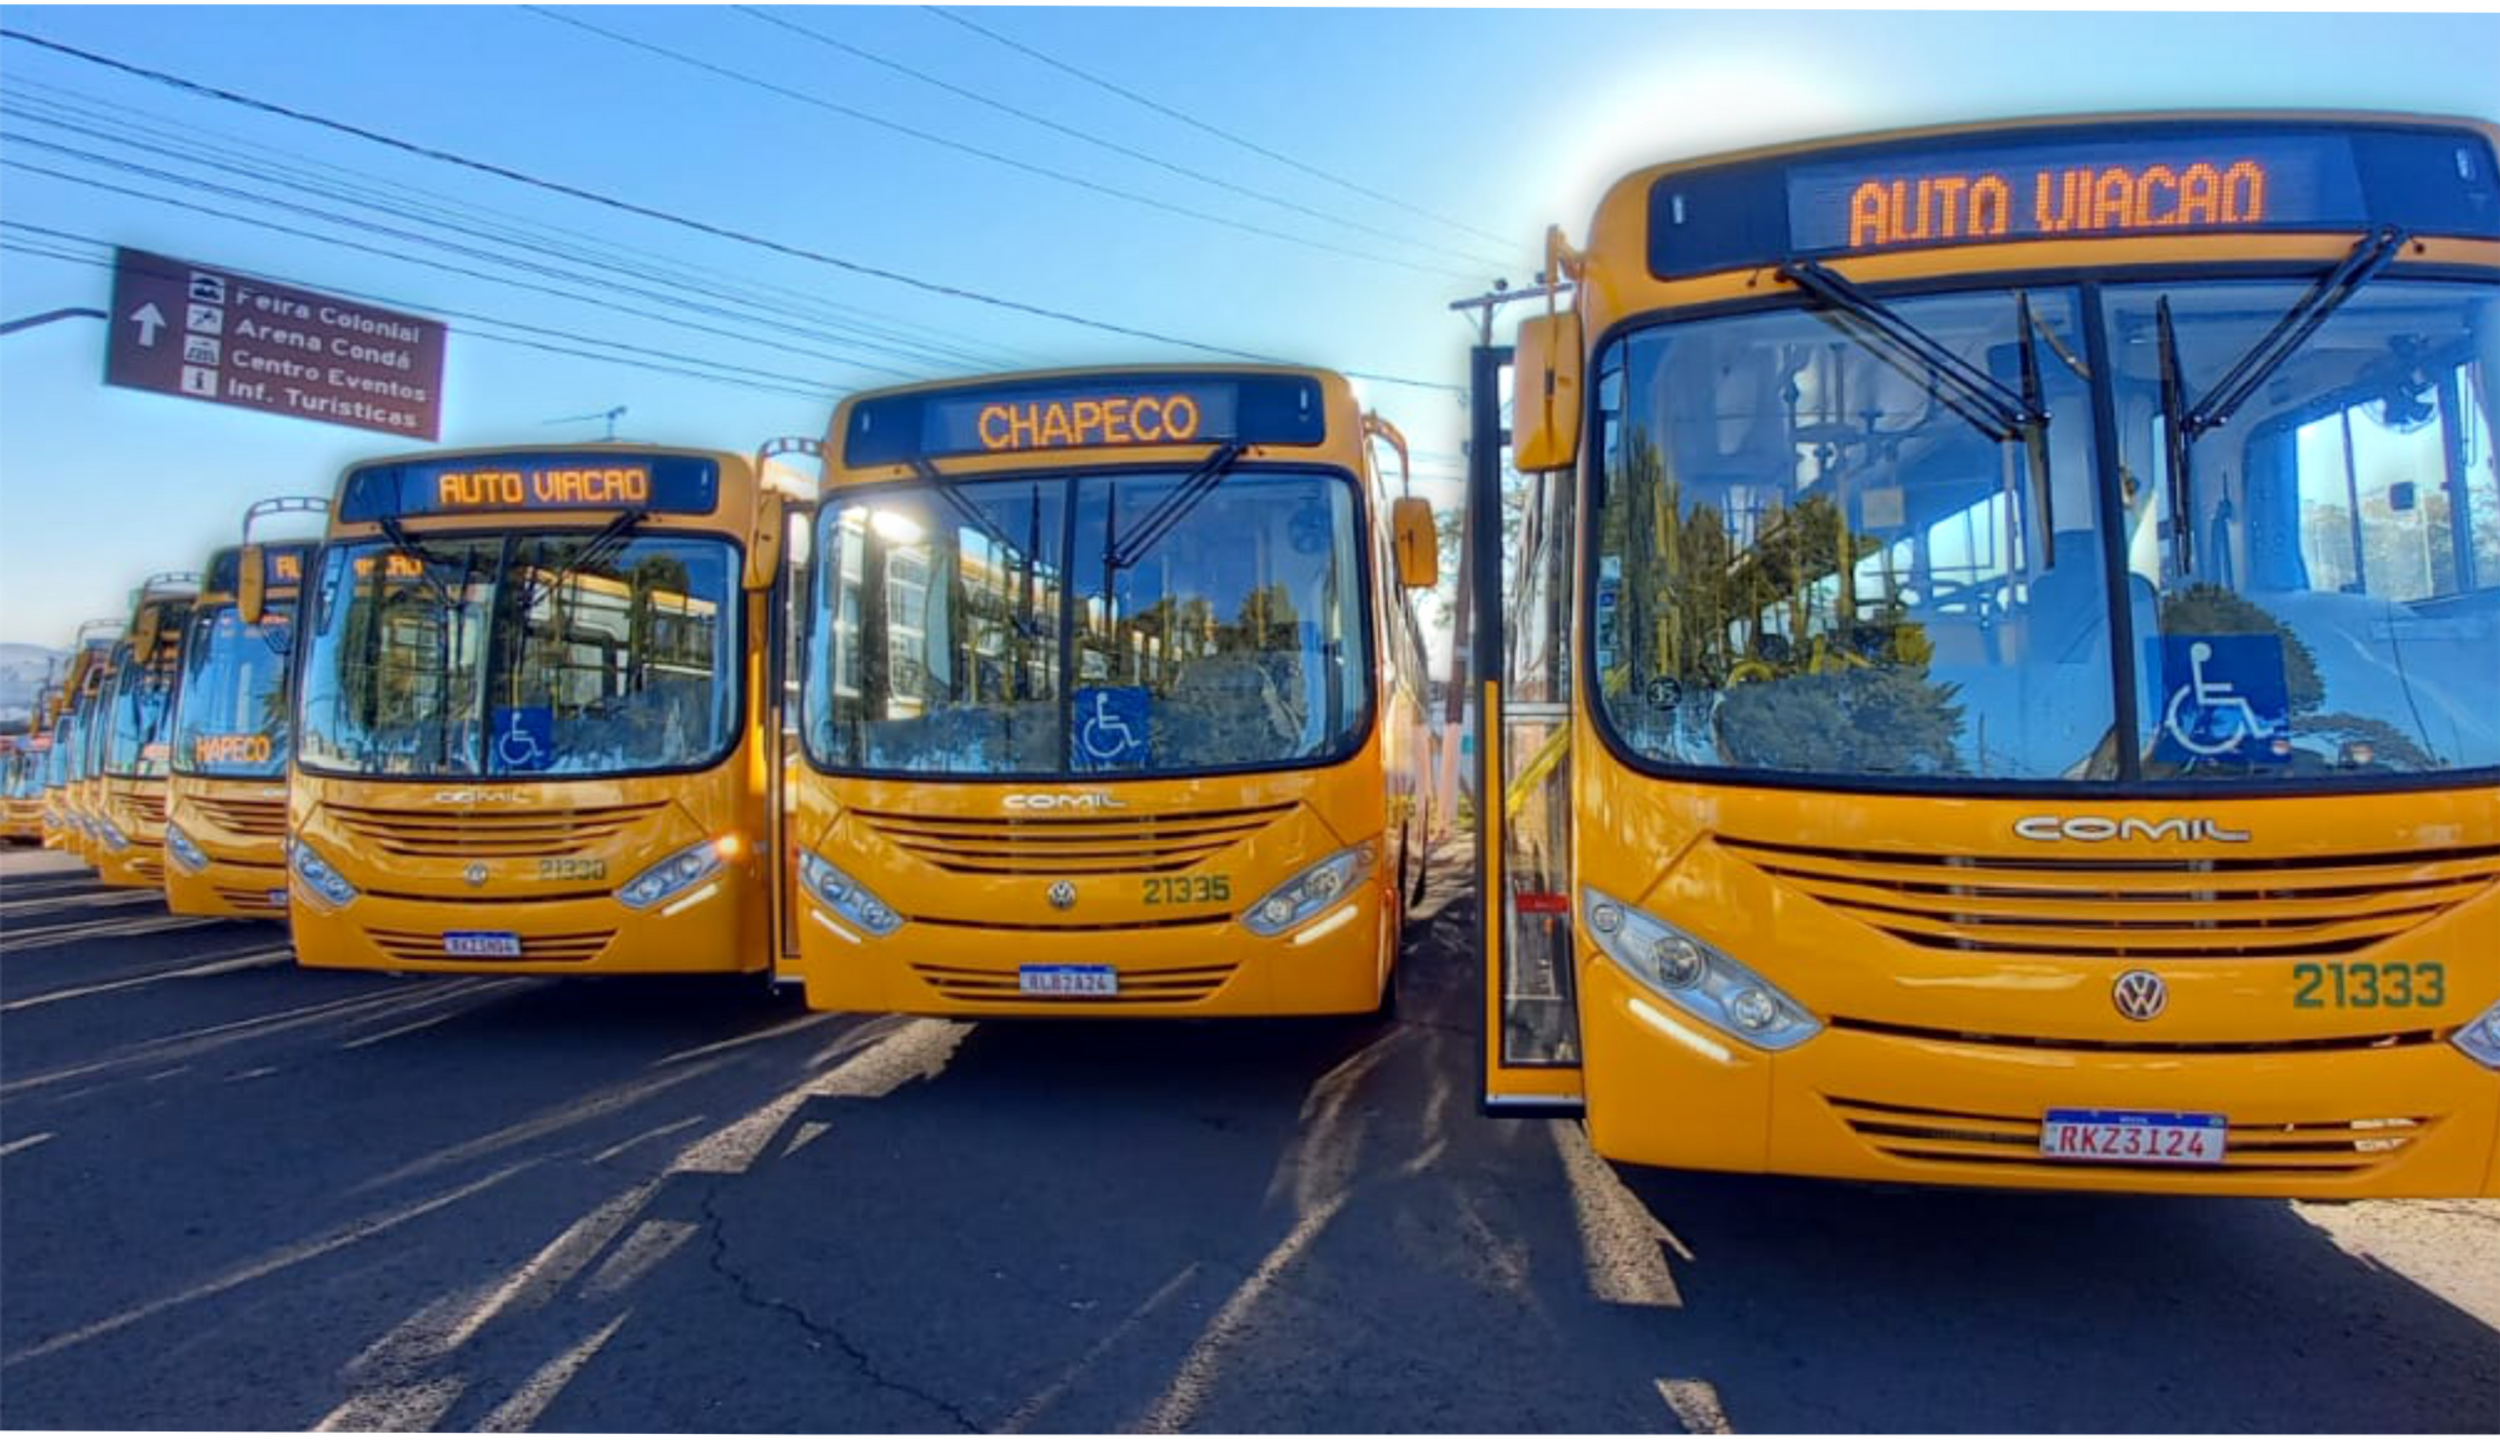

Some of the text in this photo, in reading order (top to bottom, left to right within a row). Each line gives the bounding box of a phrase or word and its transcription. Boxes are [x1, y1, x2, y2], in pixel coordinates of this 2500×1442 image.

[1849, 158, 2267, 248] AUTO VIACAO
[235, 287, 420, 344] Feira Colonial
[235, 318, 322, 351] Arena
[228, 378, 274, 403] Inf.
[232, 350, 426, 402] Centro Eventos
[979, 395, 1199, 449] CHAPECO
[439, 468, 648, 503] AUTO VIACAO
[1002, 793, 1128, 809] COMIL
[2014, 816, 2250, 842] COMIL
[1143, 875, 1231, 904] 21335
[2293, 963, 2445, 1008] 21333
[2058, 1126, 2206, 1158] RKZ3I24
